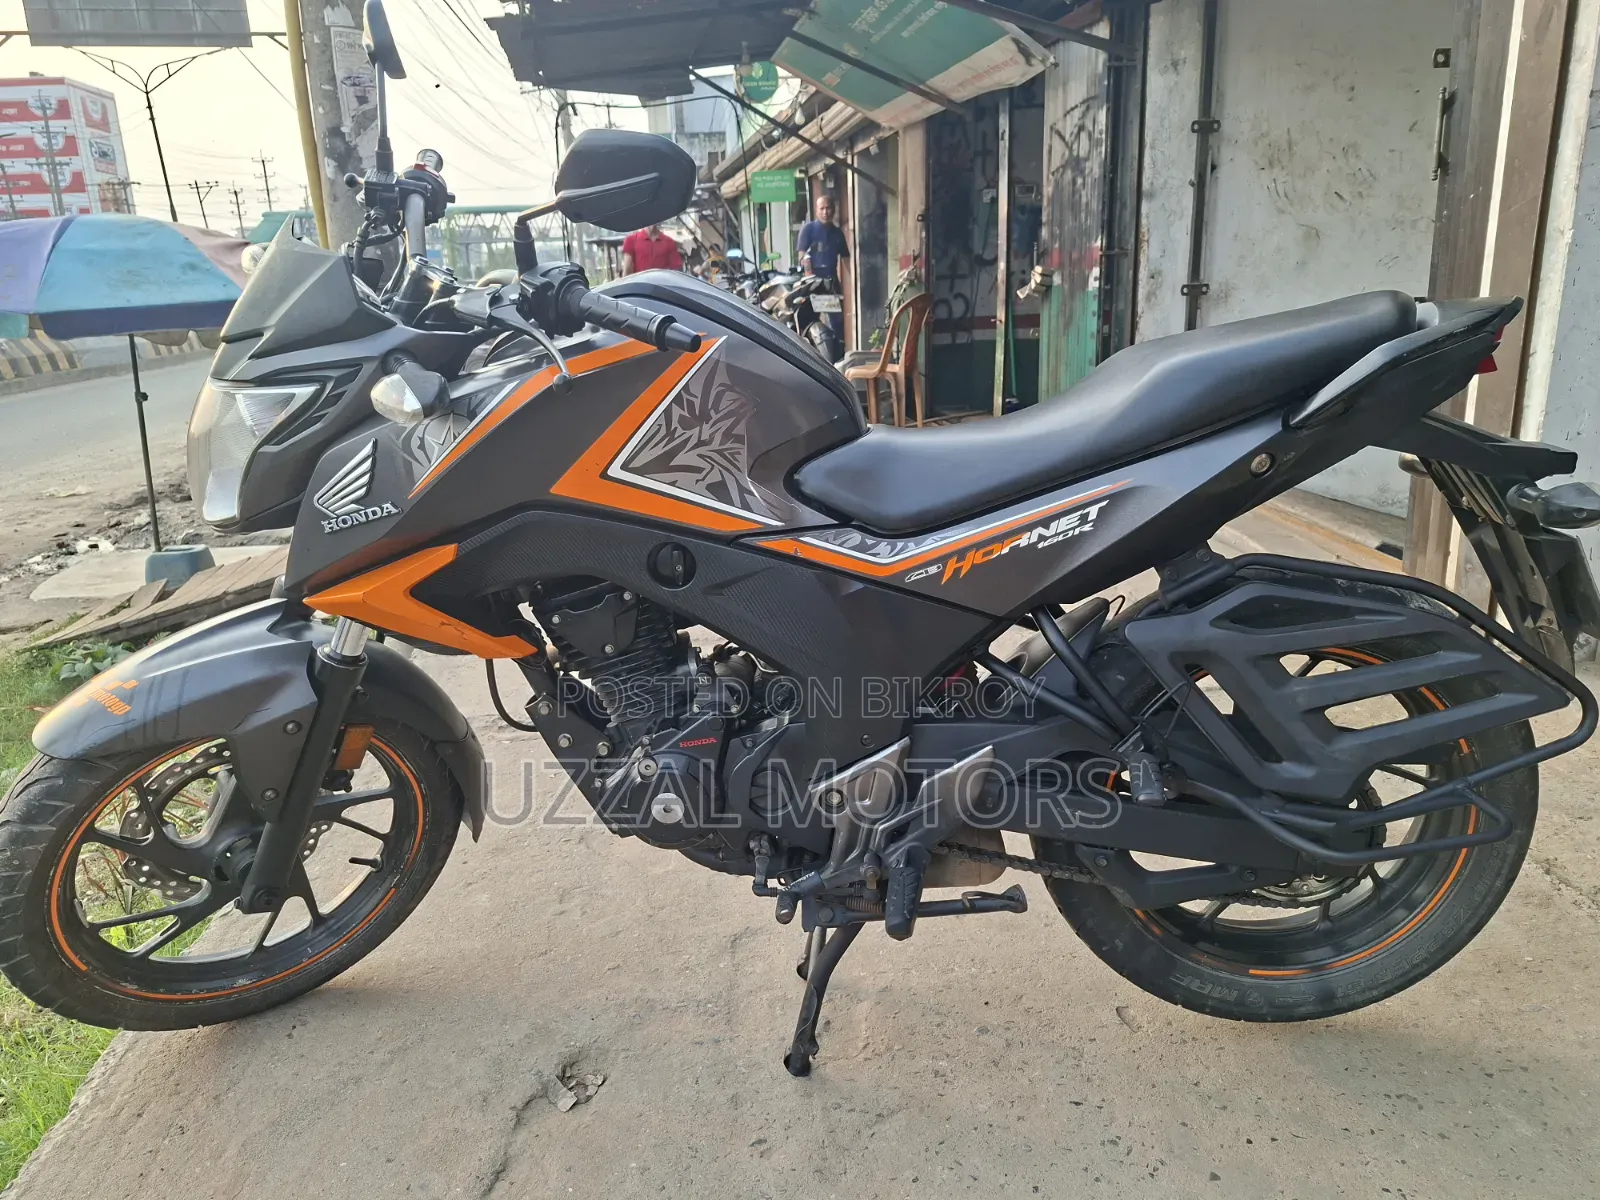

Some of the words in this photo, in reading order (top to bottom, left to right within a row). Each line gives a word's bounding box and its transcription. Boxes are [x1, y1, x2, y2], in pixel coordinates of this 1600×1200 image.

[321, 501, 402, 533] HONDA
[941, 500, 1109, 585] HORNET
[1036, 522, 1094, 549] 160R
[679, 737, 718, 748] HONDA
[1170, 973, 1239, 1001] MRF
